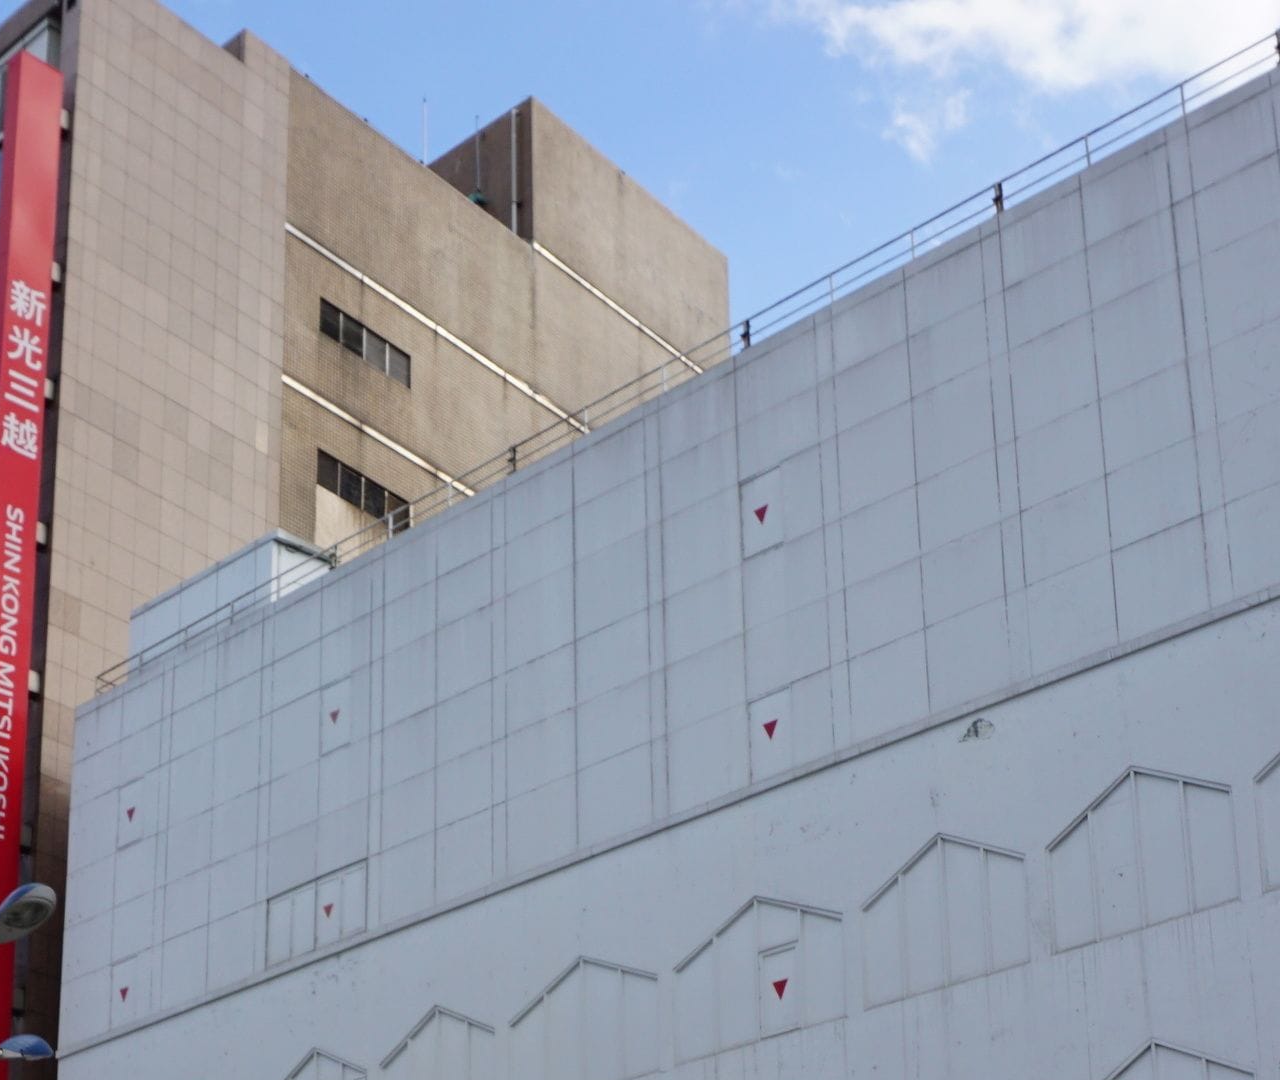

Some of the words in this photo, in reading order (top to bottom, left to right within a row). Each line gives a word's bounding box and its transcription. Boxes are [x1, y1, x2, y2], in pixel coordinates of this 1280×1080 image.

[0, 279, 47, 461] 新光三越
[2, 503, 25, 574] SHIN
